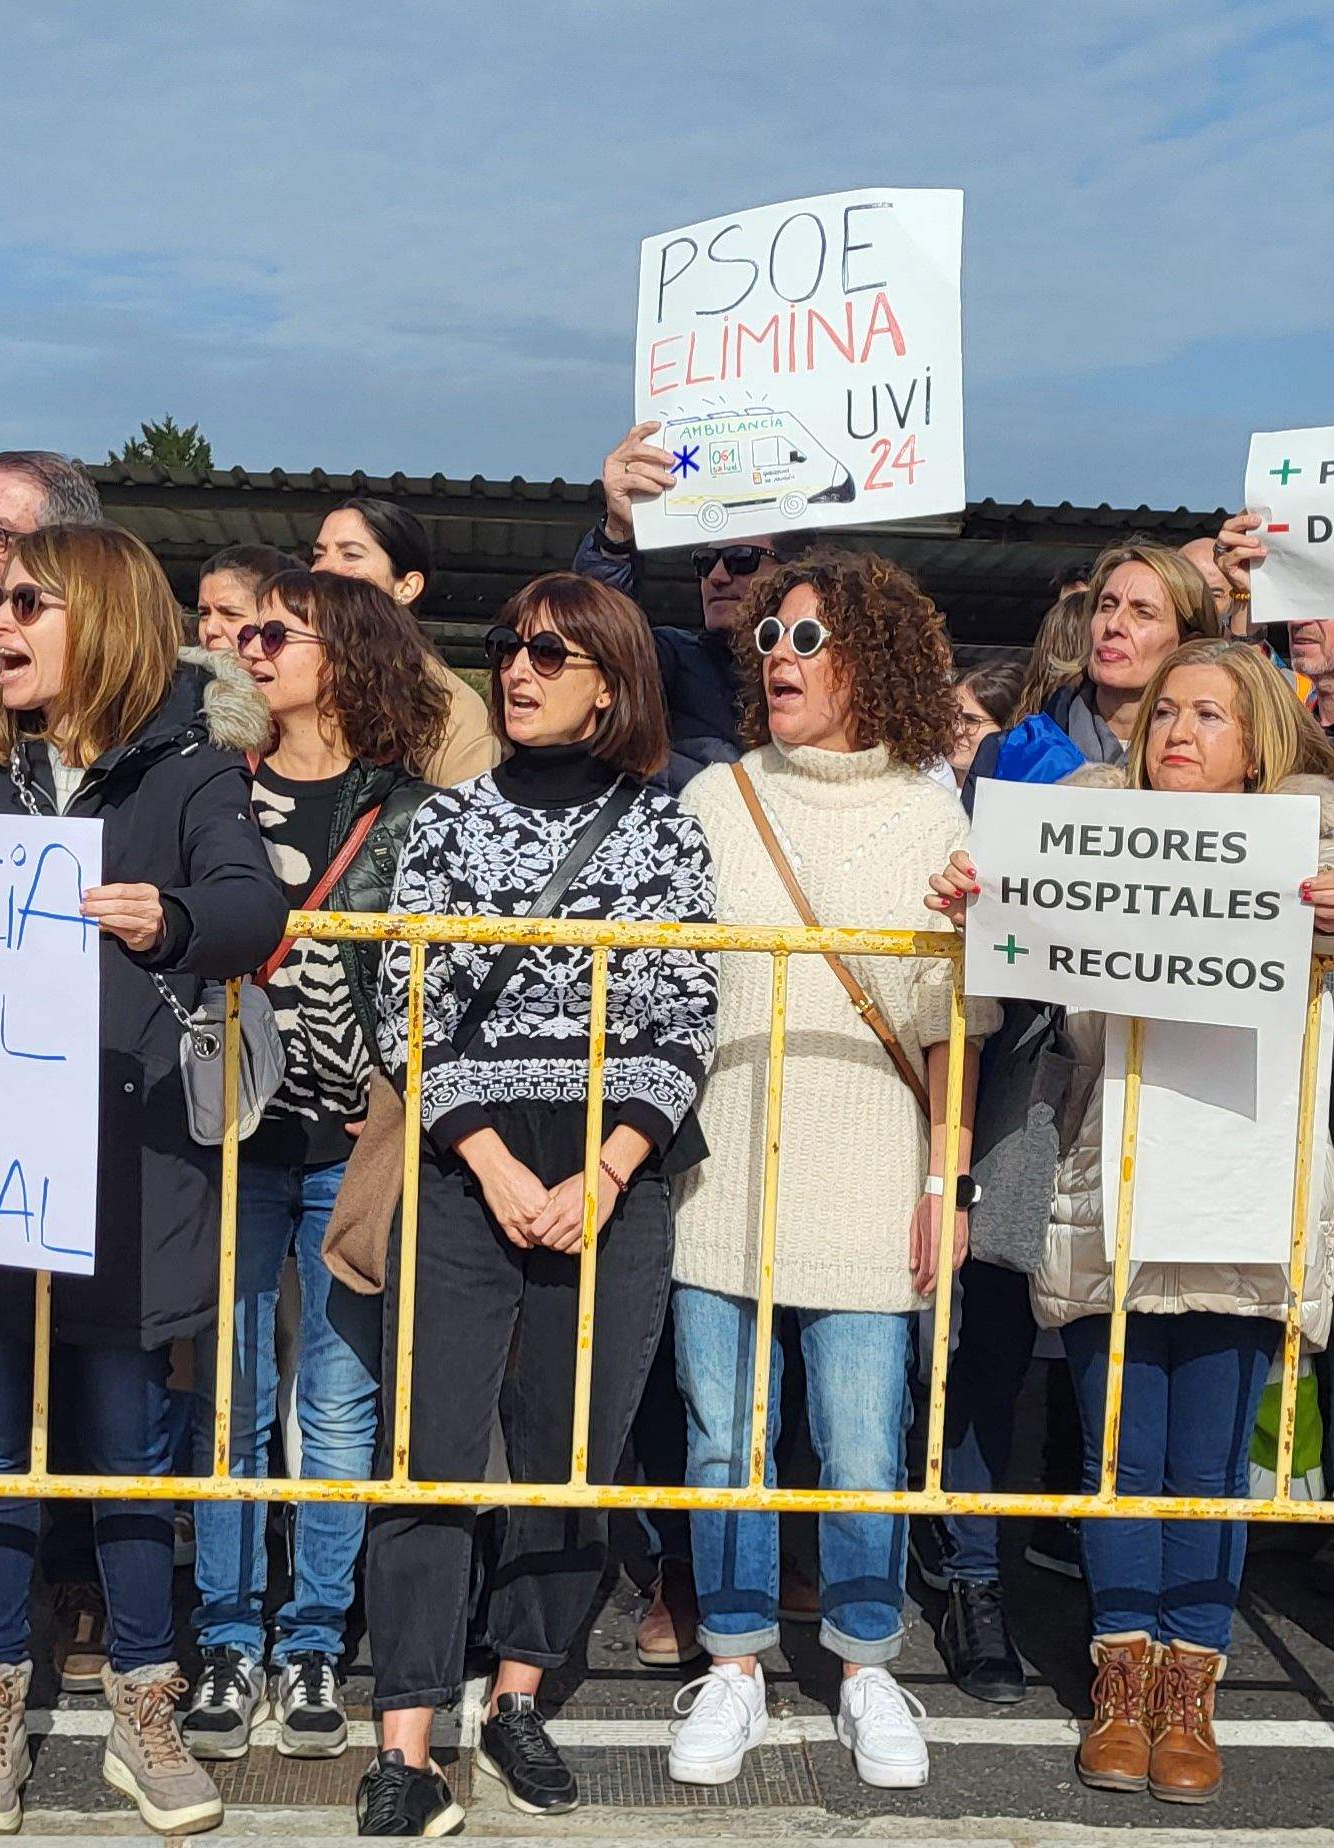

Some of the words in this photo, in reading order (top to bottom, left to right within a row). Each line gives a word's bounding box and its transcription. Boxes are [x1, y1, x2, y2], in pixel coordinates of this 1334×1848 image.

[657, 202, 894, 323] PSOE
[864, 434, 926, 491] 24
[1039, 821, 1247, 865] MEJORES
[1001, 876, 1281, 921] HOSPITALES
[1048, 944, 1285, 993] RECURSOS
